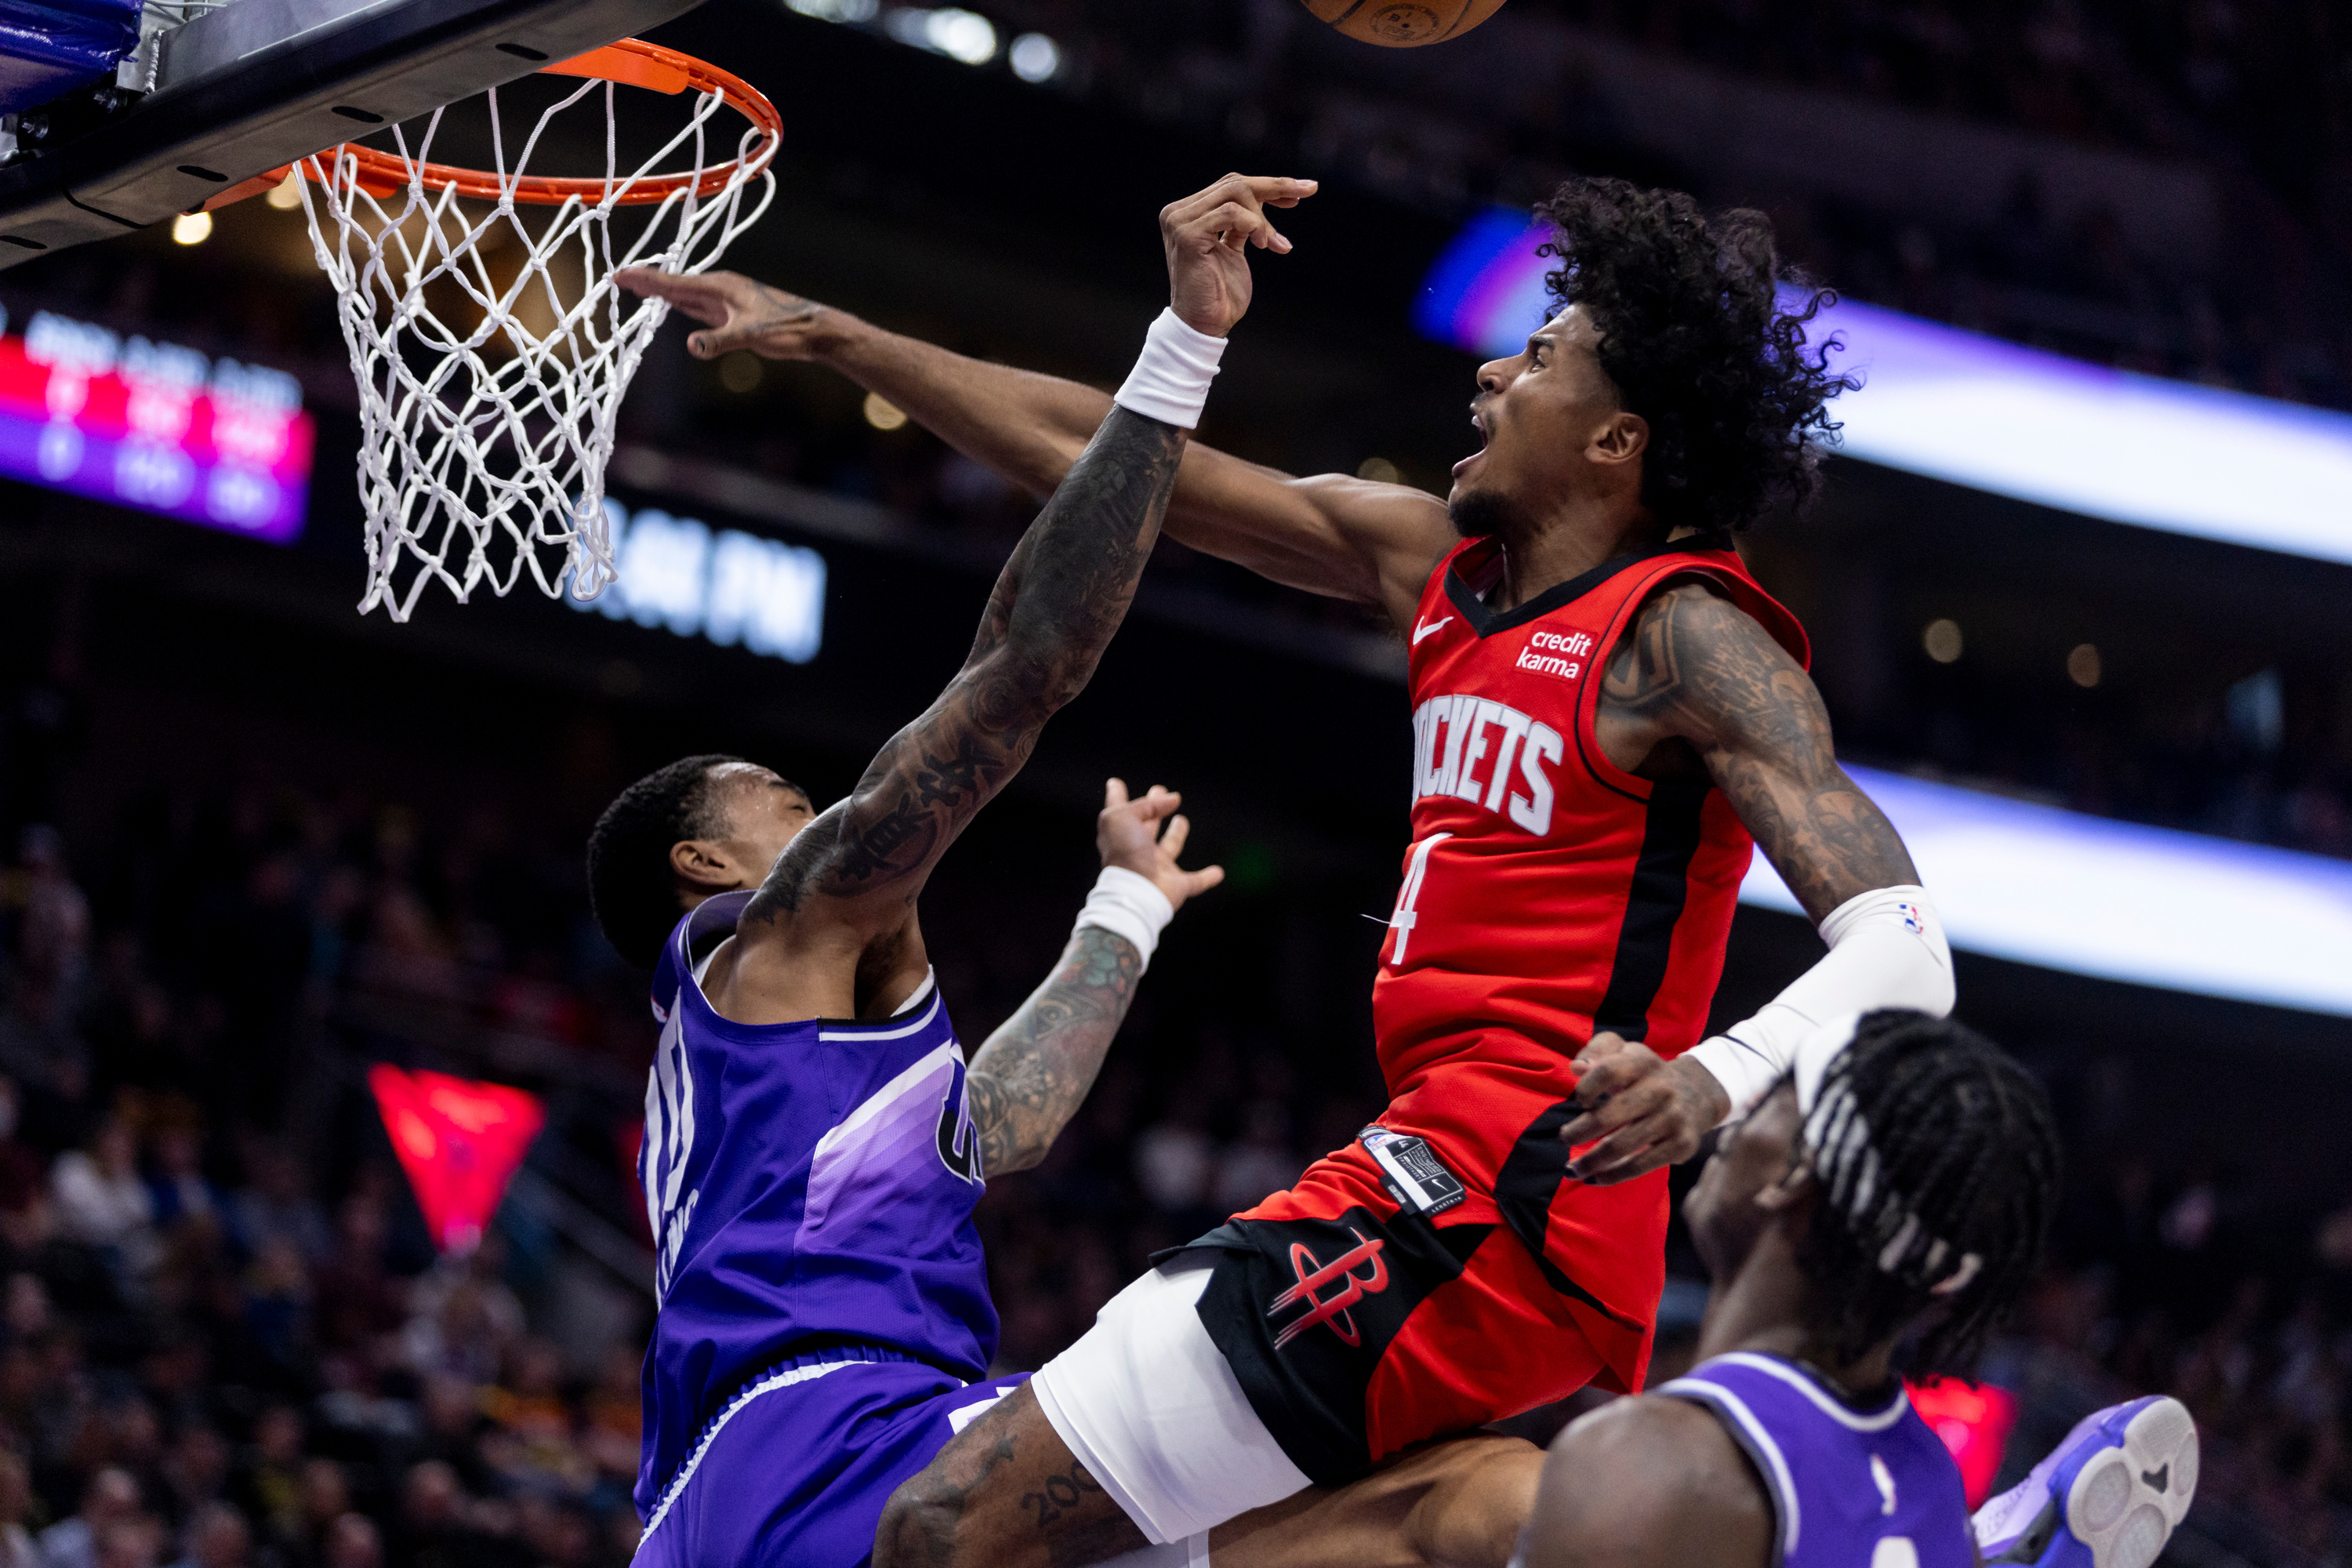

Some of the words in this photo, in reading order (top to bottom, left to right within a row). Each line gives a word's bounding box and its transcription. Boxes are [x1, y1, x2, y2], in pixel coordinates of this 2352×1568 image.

[1531, 631, 1592, 657] credit
[1515, 646, 1580, 679] karma
[1412, 694, 1564, 837] OCKETS
